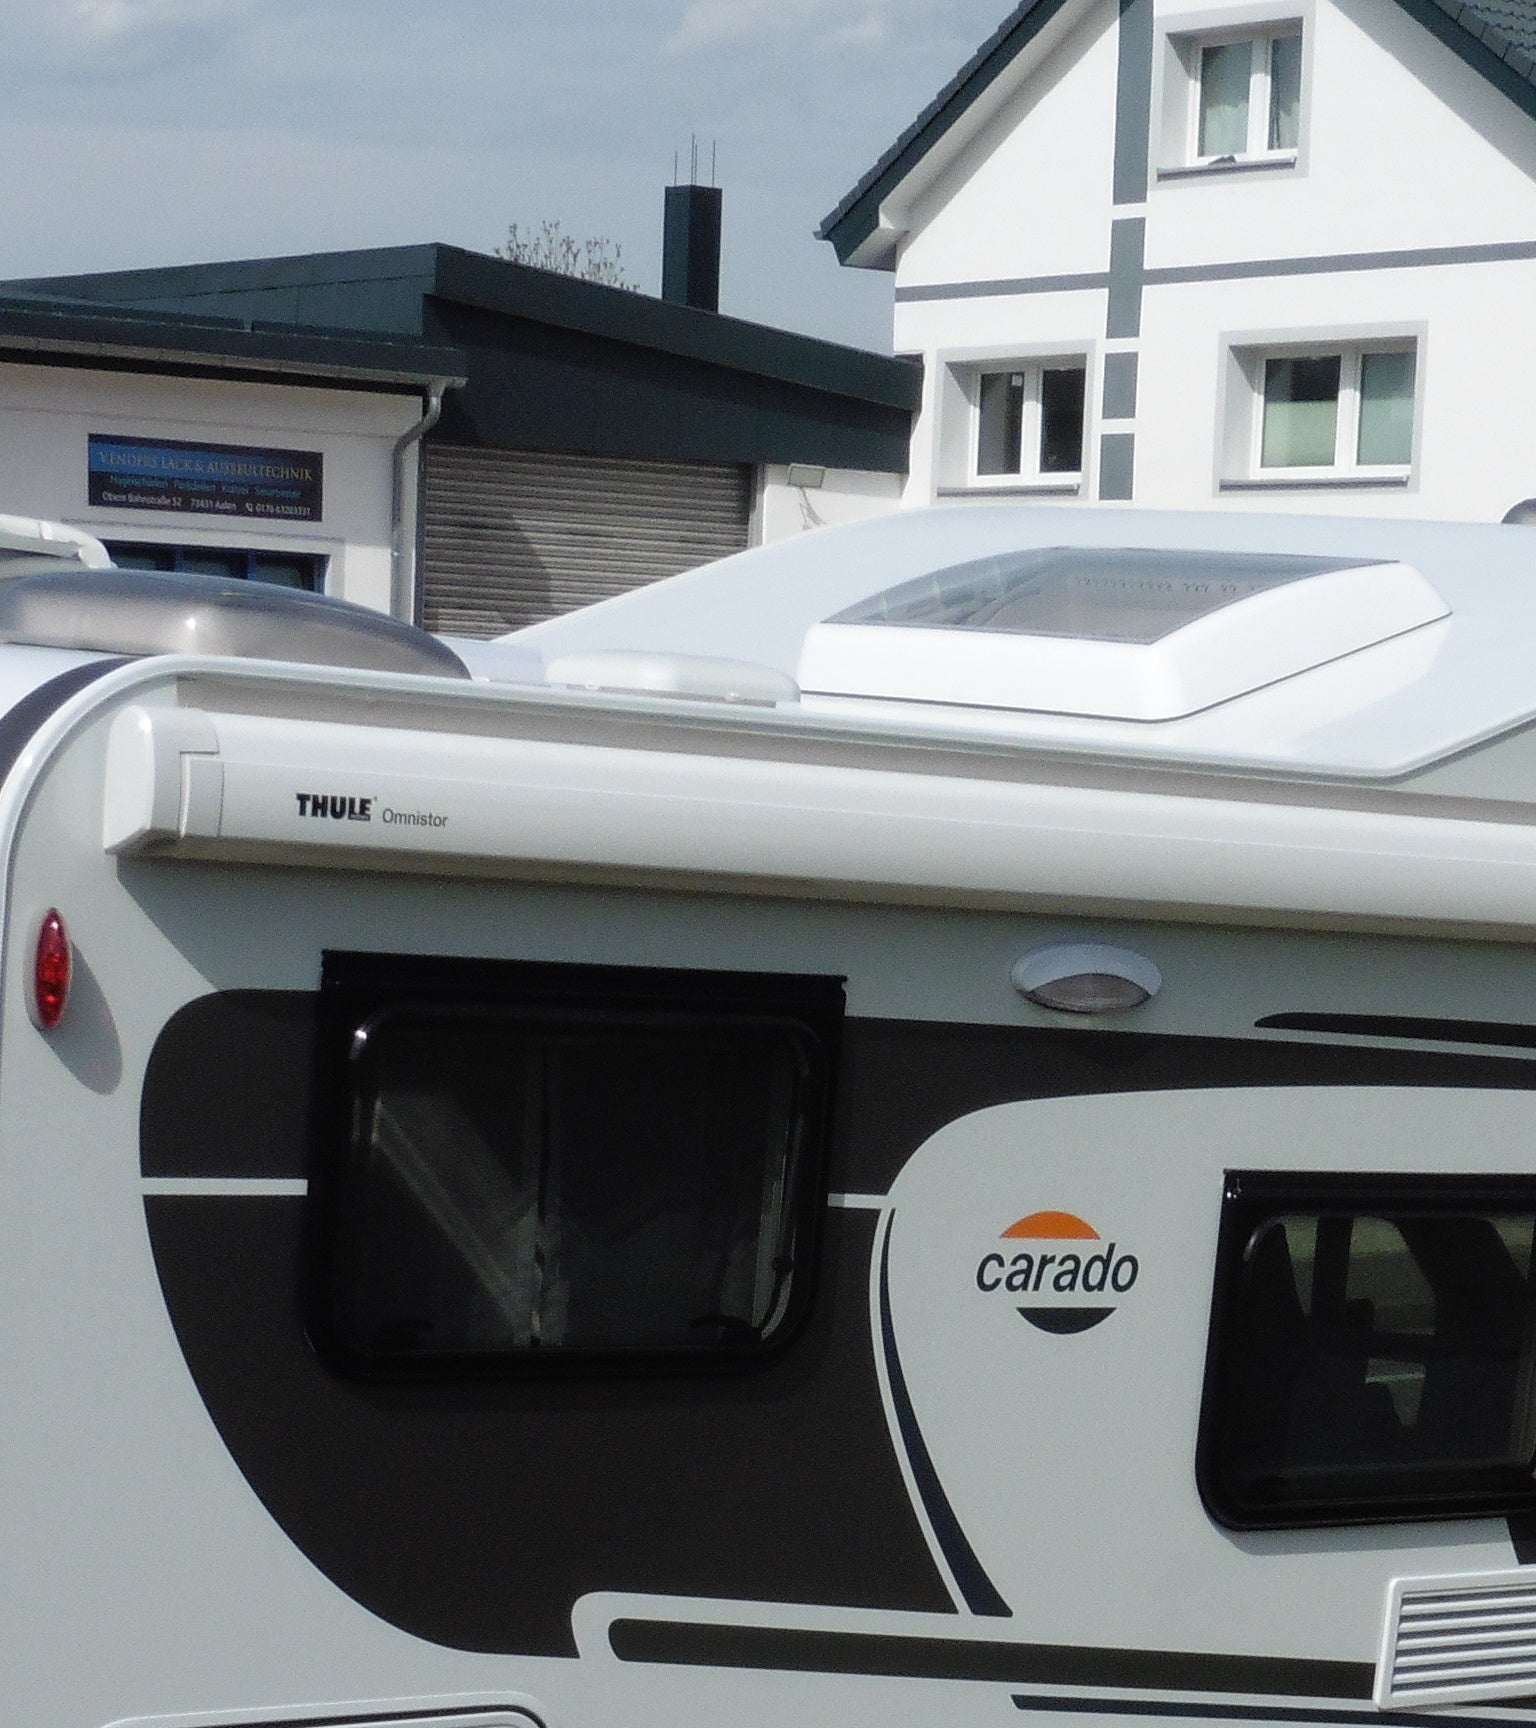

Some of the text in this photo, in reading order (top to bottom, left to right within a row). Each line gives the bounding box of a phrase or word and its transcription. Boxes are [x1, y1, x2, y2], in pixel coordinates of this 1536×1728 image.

[296, 793, 449, 828] THULE Omnistor
[976, 1242, 1139, 1293] carado
